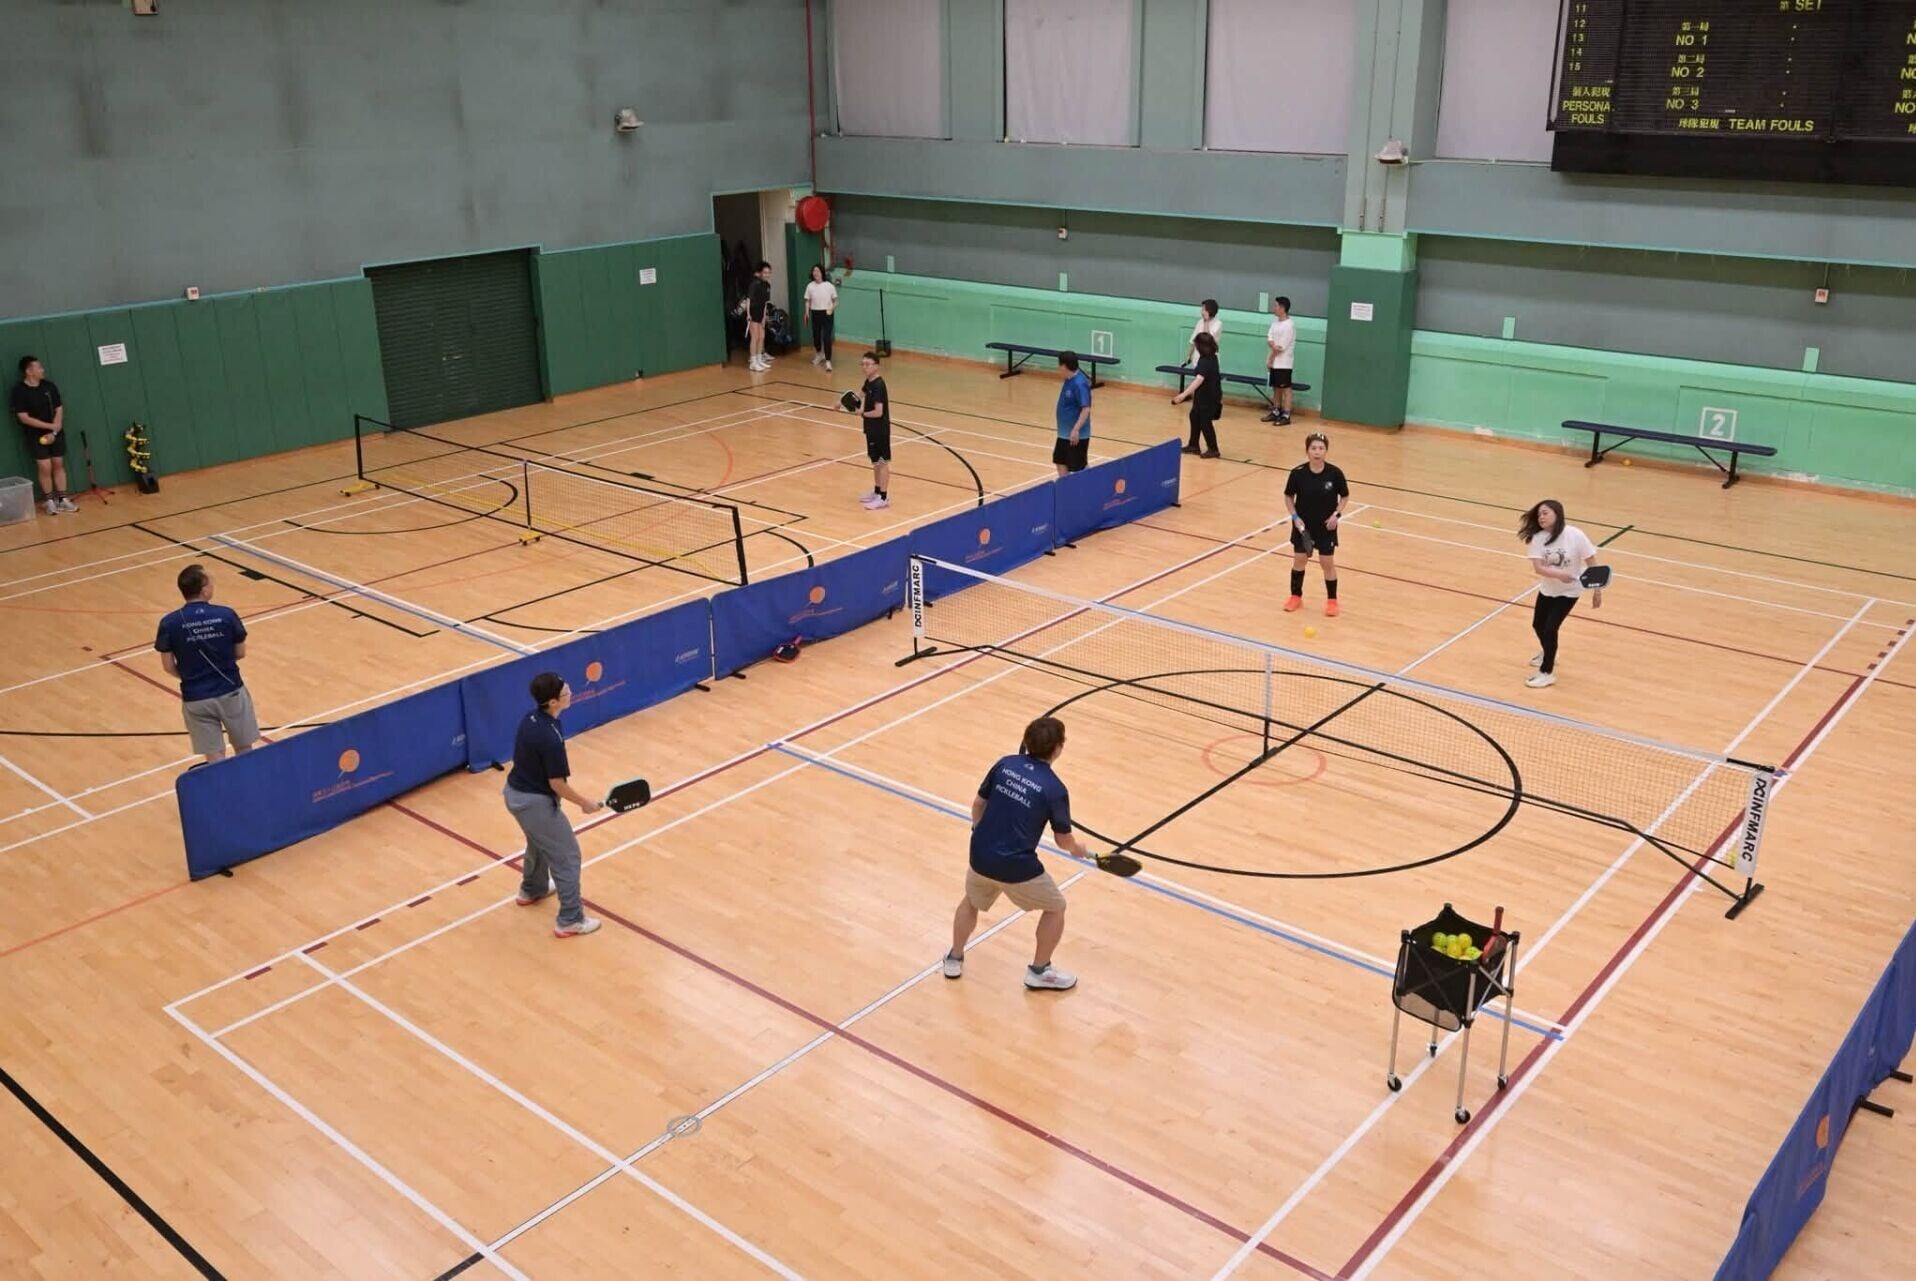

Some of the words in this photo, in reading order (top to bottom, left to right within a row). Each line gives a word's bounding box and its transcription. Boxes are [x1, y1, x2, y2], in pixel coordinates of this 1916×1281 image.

[1575, 4, 1587, 13] 11
[1574, 19, 1586, 28] 12
[1572, 33, 1584, 42] 13
[1675, 34, 1695, 46] NO
[1702, 34, 1708, 46] 1
[1571, 48, 1583, 56] 14
[1569, 62, 1581, 71] 15
[1671, 66, 1690, 78] NO
[1696, 66, 1705, 78] 2
[1666, 99, 1684, 110] NO
[1691, 99, 1699, 110] 3
[1571, 114, 1605, 124] FOULS
[1729, 118, 1766, 131] TEAM
[1770, 119, 1814, 132] FOULS
[1711, 413, 1725, 436] 2
[1001, 767, 1021, 781] HONG
[1021, 776, 1042, 793] KONG
[1006, 779, 1027, 794] CHINA
[995, 783, 1032, 808] PICKLEBALL
